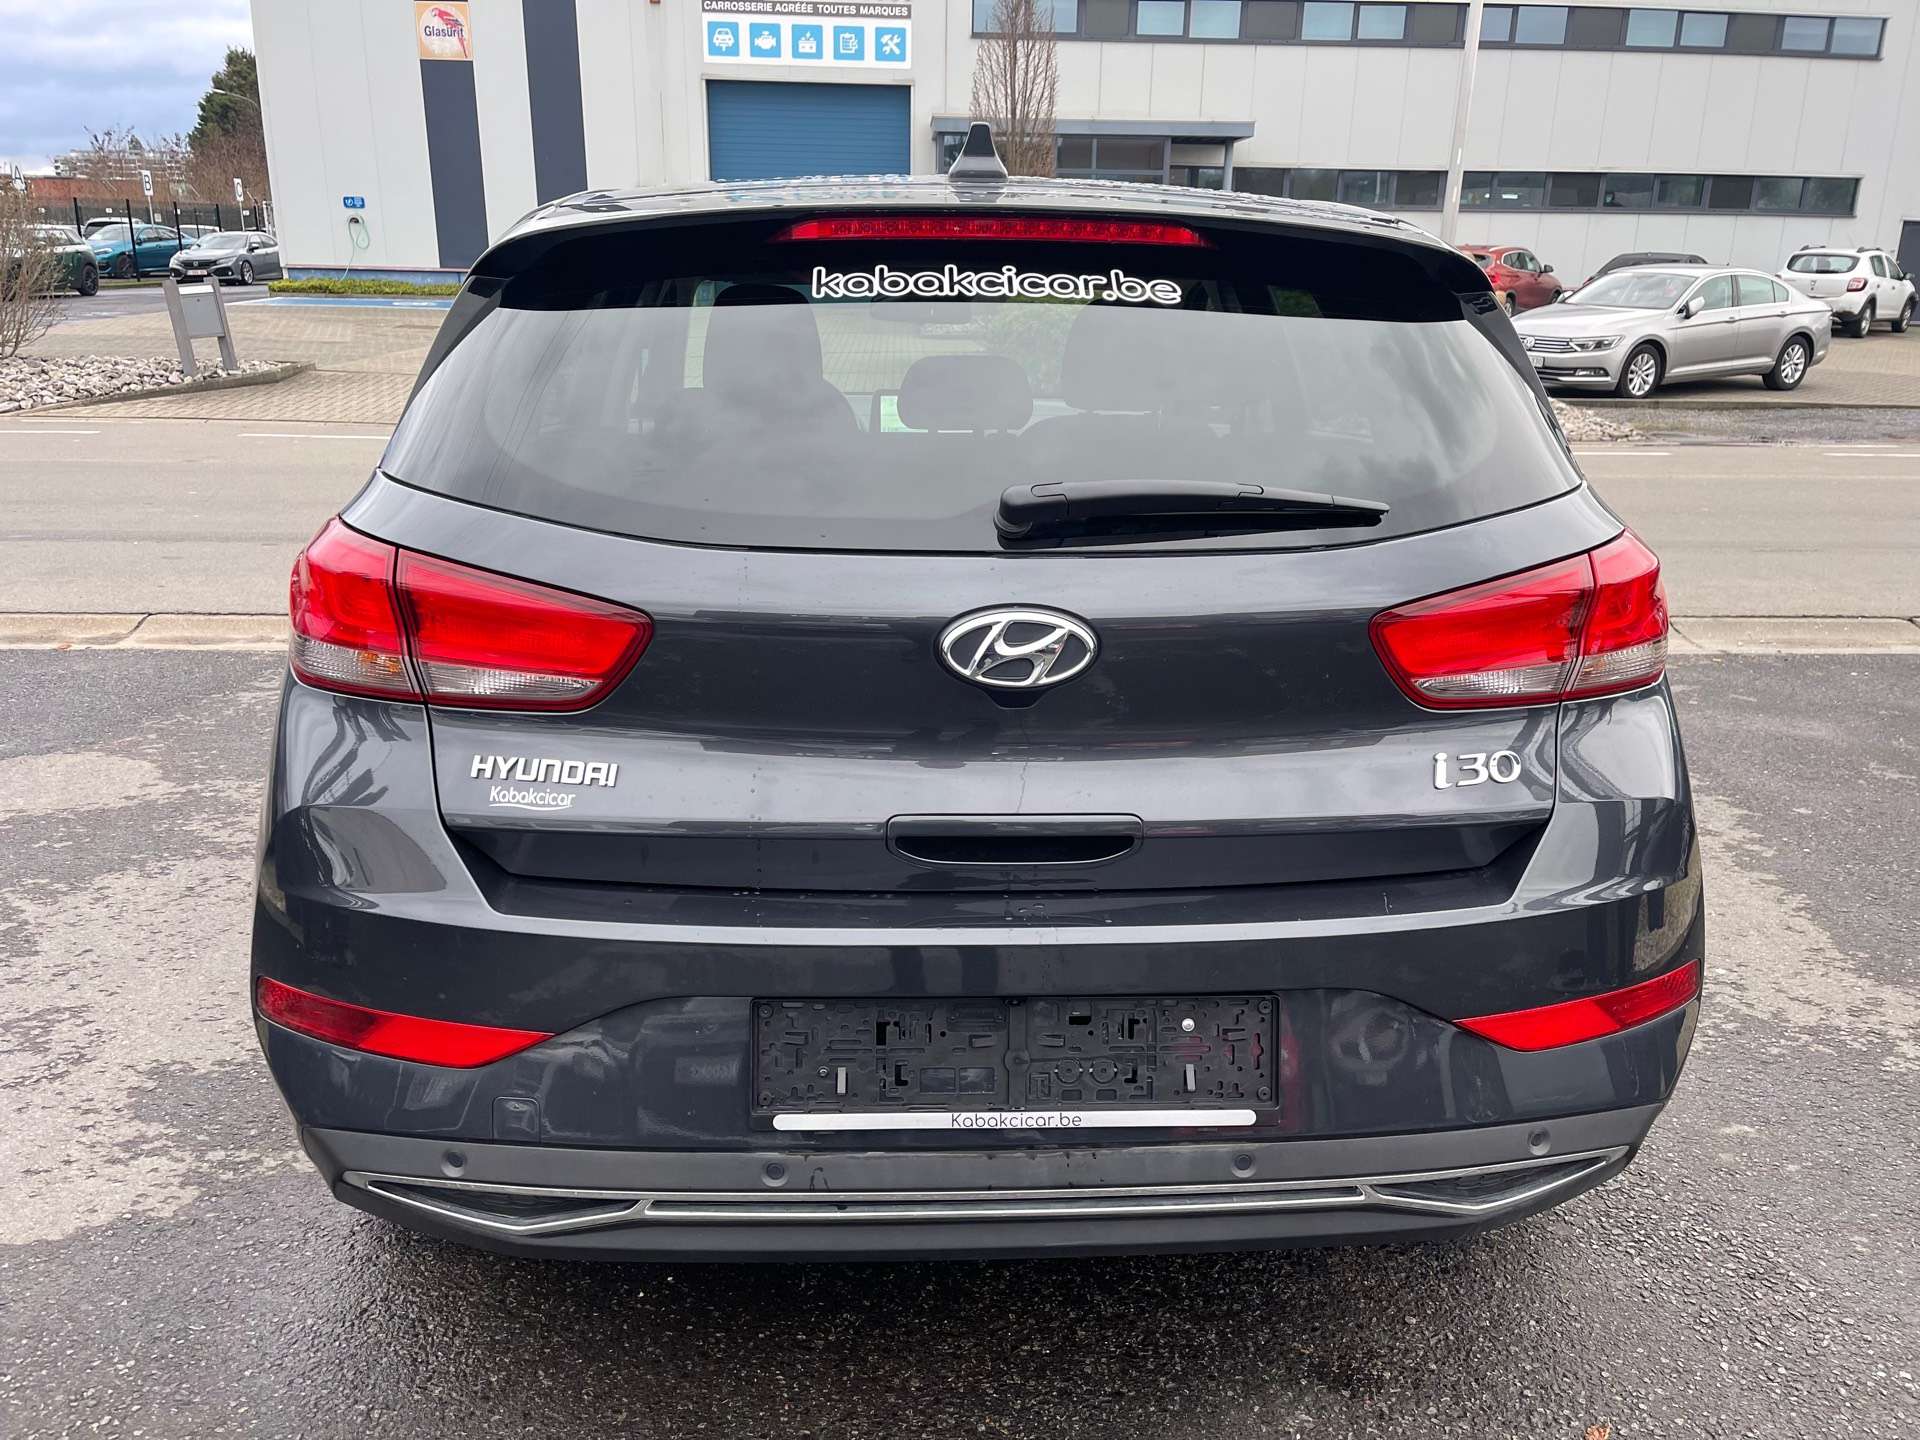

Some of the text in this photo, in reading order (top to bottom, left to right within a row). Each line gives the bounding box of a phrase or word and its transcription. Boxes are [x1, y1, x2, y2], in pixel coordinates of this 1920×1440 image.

[704, 0, 908, 16] CARROSSERIE AGRÉÉE TOUTES MARQUES
[424, 25, 464, 37] Glasurit
[143, 174, 152, 191] B
[812, 264, 1182, 304] kabakcicar.be
[470, 754, 619, 787] HYUNDAI
[489, 785, 577, 807] Kabakcicar
[951, 1112, 1082, 1128] Kabakcicar.be
